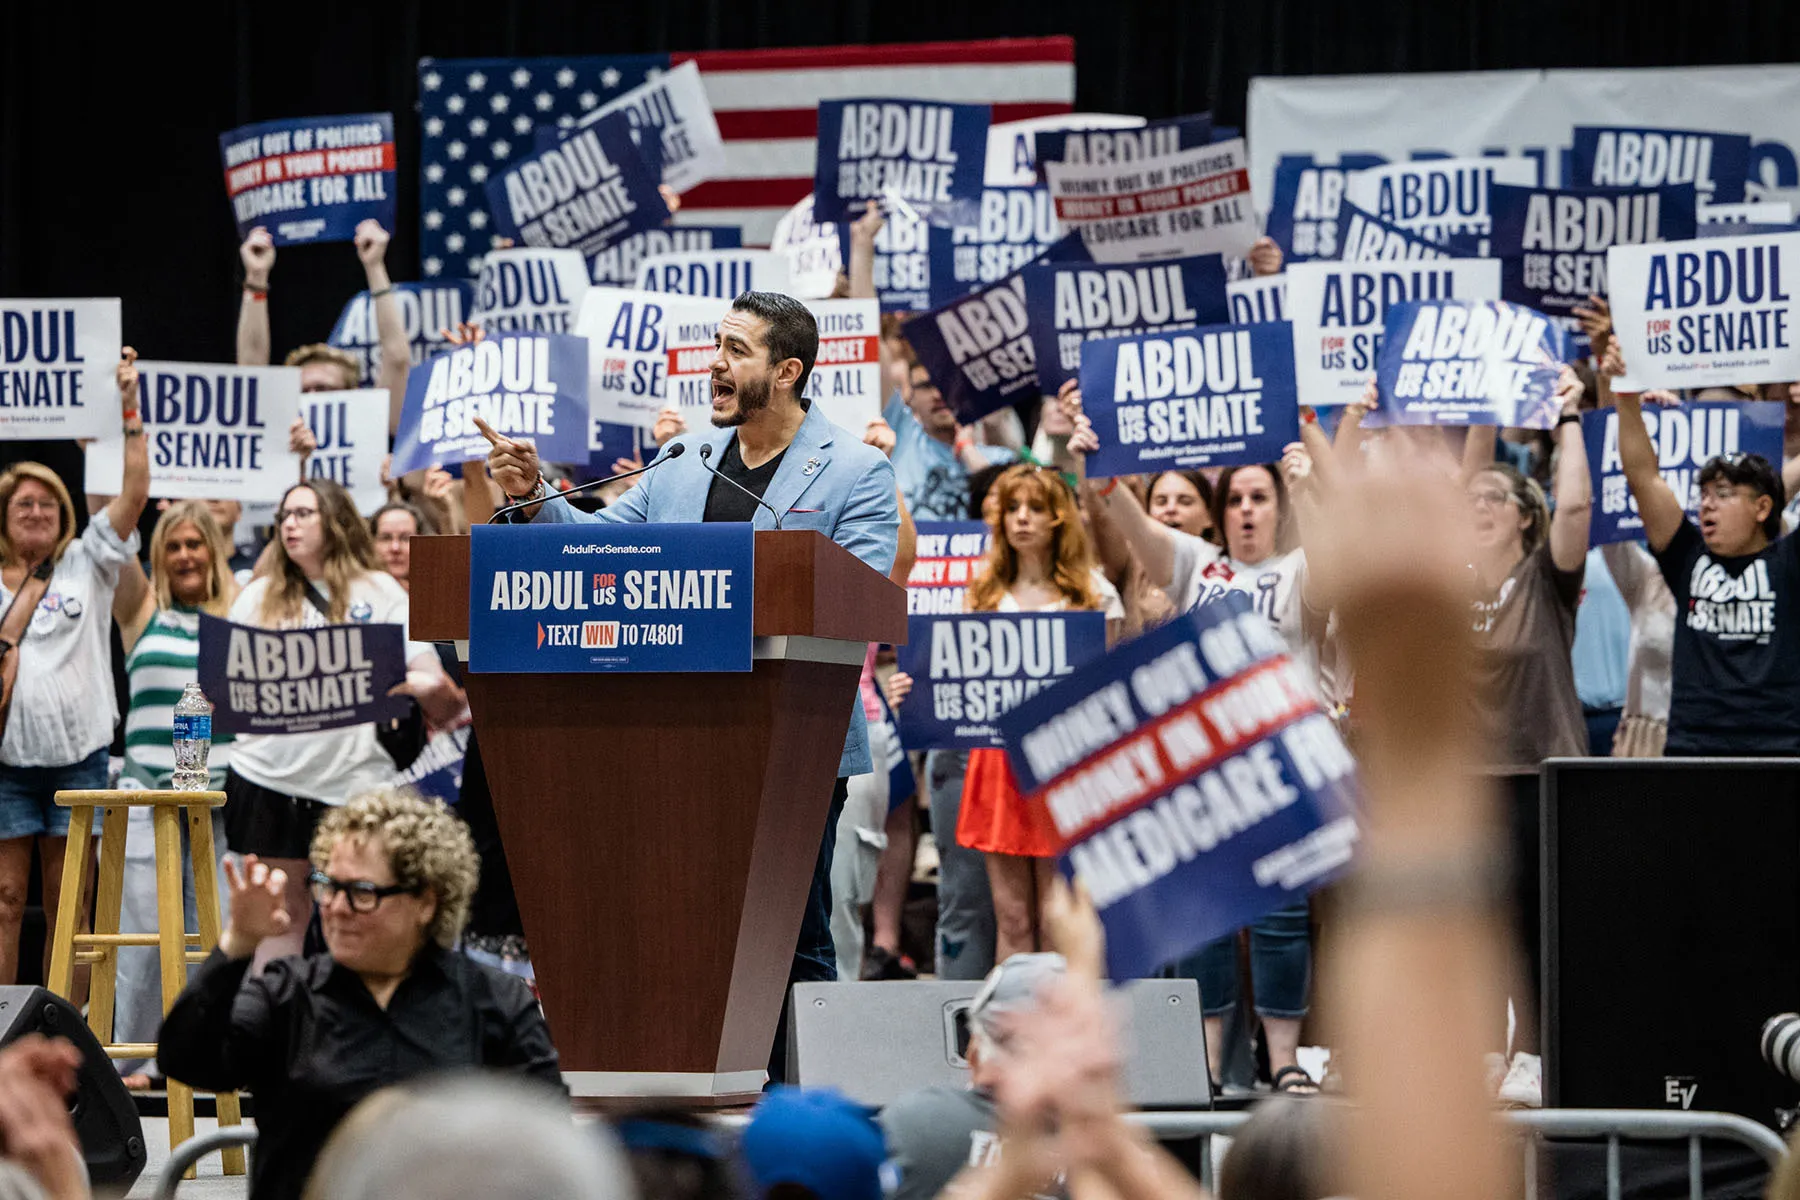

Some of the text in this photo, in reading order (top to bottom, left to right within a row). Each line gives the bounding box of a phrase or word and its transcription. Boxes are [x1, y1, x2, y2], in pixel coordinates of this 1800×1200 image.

[838, 104, 958, 163] ABDUL
[504, 129, 621, 227] ABDUL
[1592, 132, 1716, 192] ABDUL
[310, 175, 349, 207] FOR
[353, 171, 387, 202] ALL
[542, 176, 638, 247] SENATE
[1169, 212, 1206, 234] FOR
[1212, 199, 1243, 225] ALL
[1521, 192, 1667, 252] ABDUL
[1553, 253, 1609, 295] SEN
[1644, 245, 1790, 312] ABDUL
[341, 287, 463, 344] ADUL
[1054, 265, 1197, 330] ABDUL
[3, 309, 84, 364] DUL
[679, 323, 718, 342] MONE
[1321, 336, 1345, 351] FOR
[1402, 306, 1547, 363] ABDUL
[1647, 319, 1671, 337] FOR
[1648, 309, 1789, 355] US SENATE
[423, 337, 557, 410] ABDUL
[604, 359, 627, 373] FOR
[818, 339, 867, 364] OCKET
[1115, 331, 1263, 402] ABDUL
[1322, 351, 1345, 370] US
[0, 370, 84, 407] ENATE
[603, 373, 626, 391] US
[833, 369, 865, 396] ALL
[444, 393, 556, 439] SENATE
[1119, 392, 1264, 445] US SENATE
[155, 431, 263, 470] SENATE
[562, 544, 661, 555] AbdulForSenate.com
[490, 570, 732, 610] ABDUL FOR US SENATE
[547, 624, 683, 645] TEXT WIN TO 74801
[1692, 599, 1776, 632] SENATE
[226, 627, 373, 682] ABDUL
[930, 618, 1075, 679] ABDUL
[259, 670, 374, 716] SENATE
[934, 697, 963, 720] US
